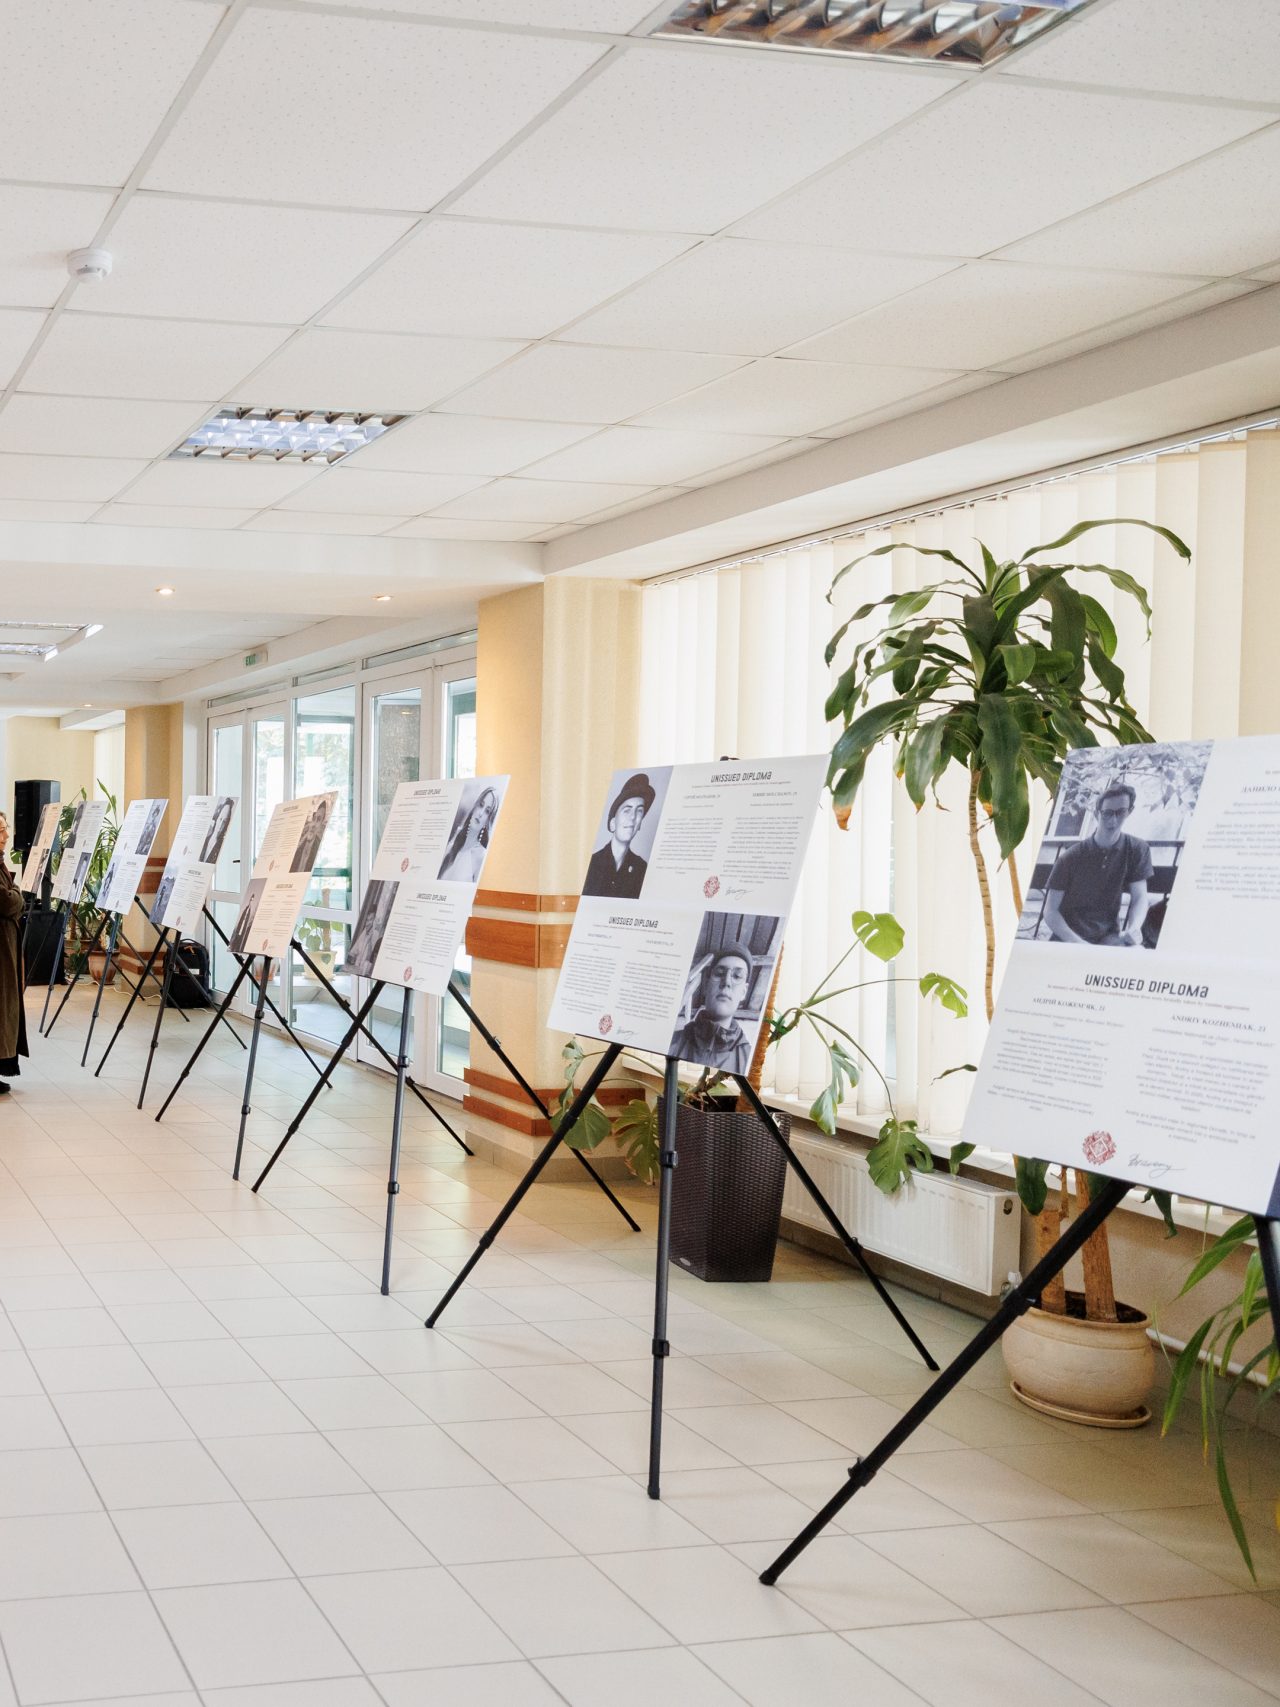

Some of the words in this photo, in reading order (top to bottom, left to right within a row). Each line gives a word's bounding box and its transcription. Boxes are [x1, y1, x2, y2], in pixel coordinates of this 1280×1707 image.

[710, 772, 741, 783] UNISSUED
[608, 916, 634, 926] UNISSUED
[1084, 973, 1145, 992] UNISSUED
